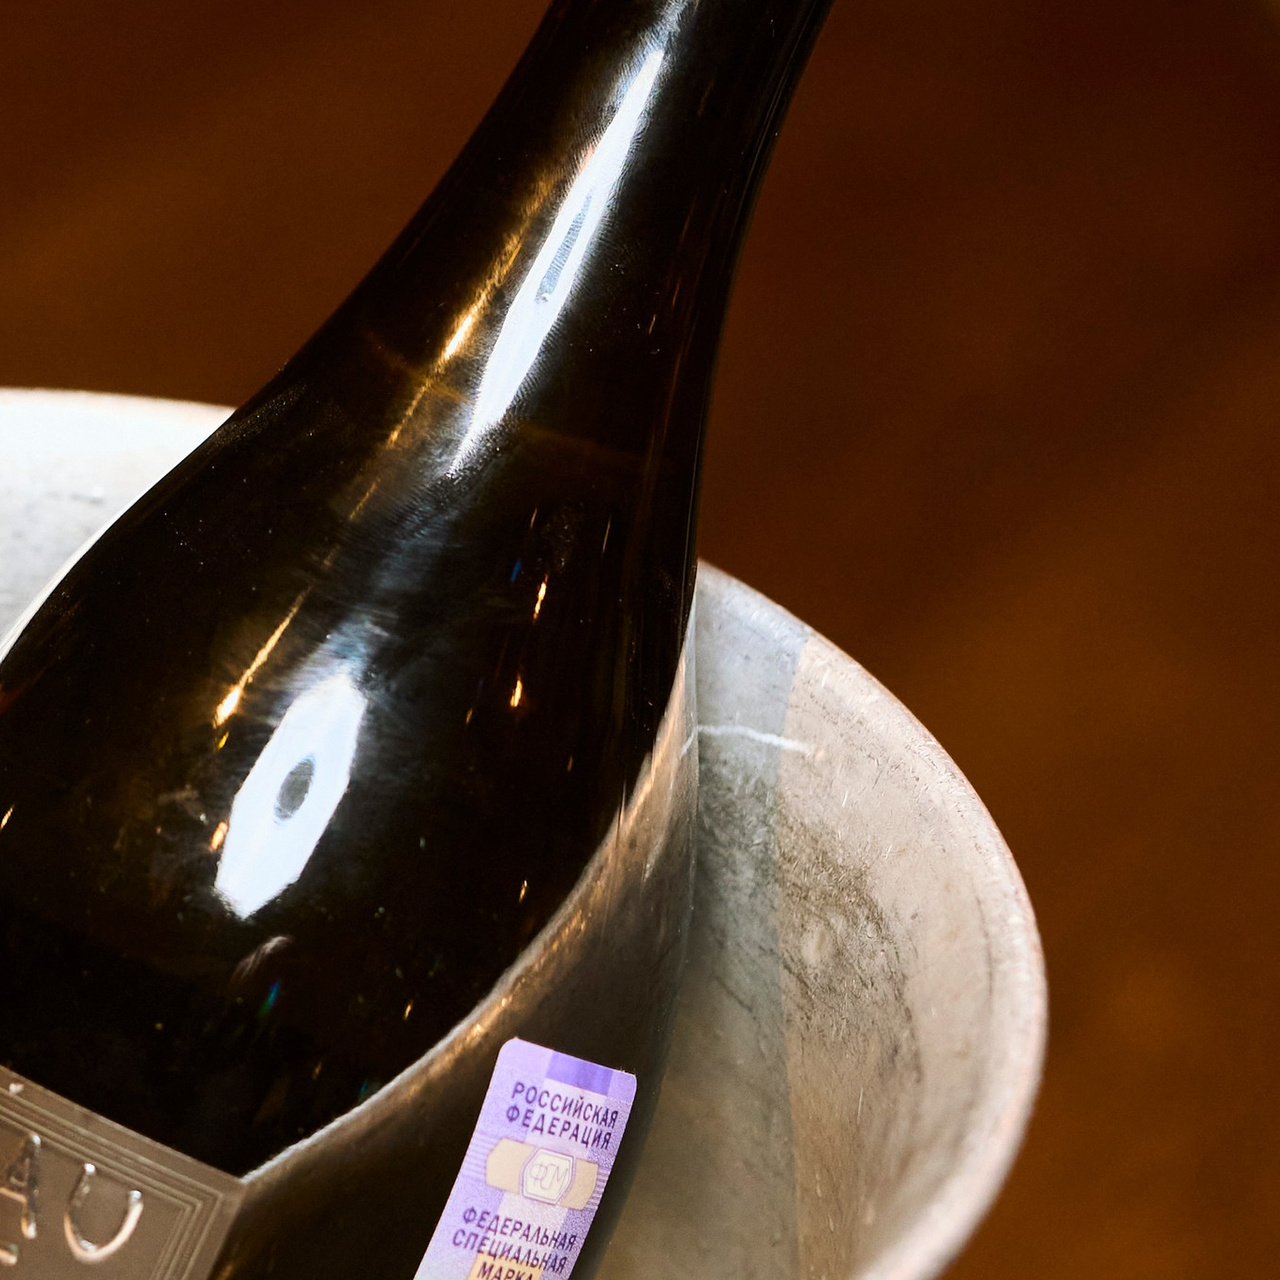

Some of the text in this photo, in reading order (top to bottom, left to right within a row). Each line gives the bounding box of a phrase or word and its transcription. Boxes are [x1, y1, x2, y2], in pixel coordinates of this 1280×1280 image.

[505, 1105, 612, 1150] ФЕДЕРАЦИЯ
[511, 1081, 619, 1130] РОССИЙСКАЯ
[452, 1229, 568, 1275] СПЕЦИАЛЬНАЯ
[463, 1206, 577, 1252] ФЕДЕРАЛЬНАЯ
